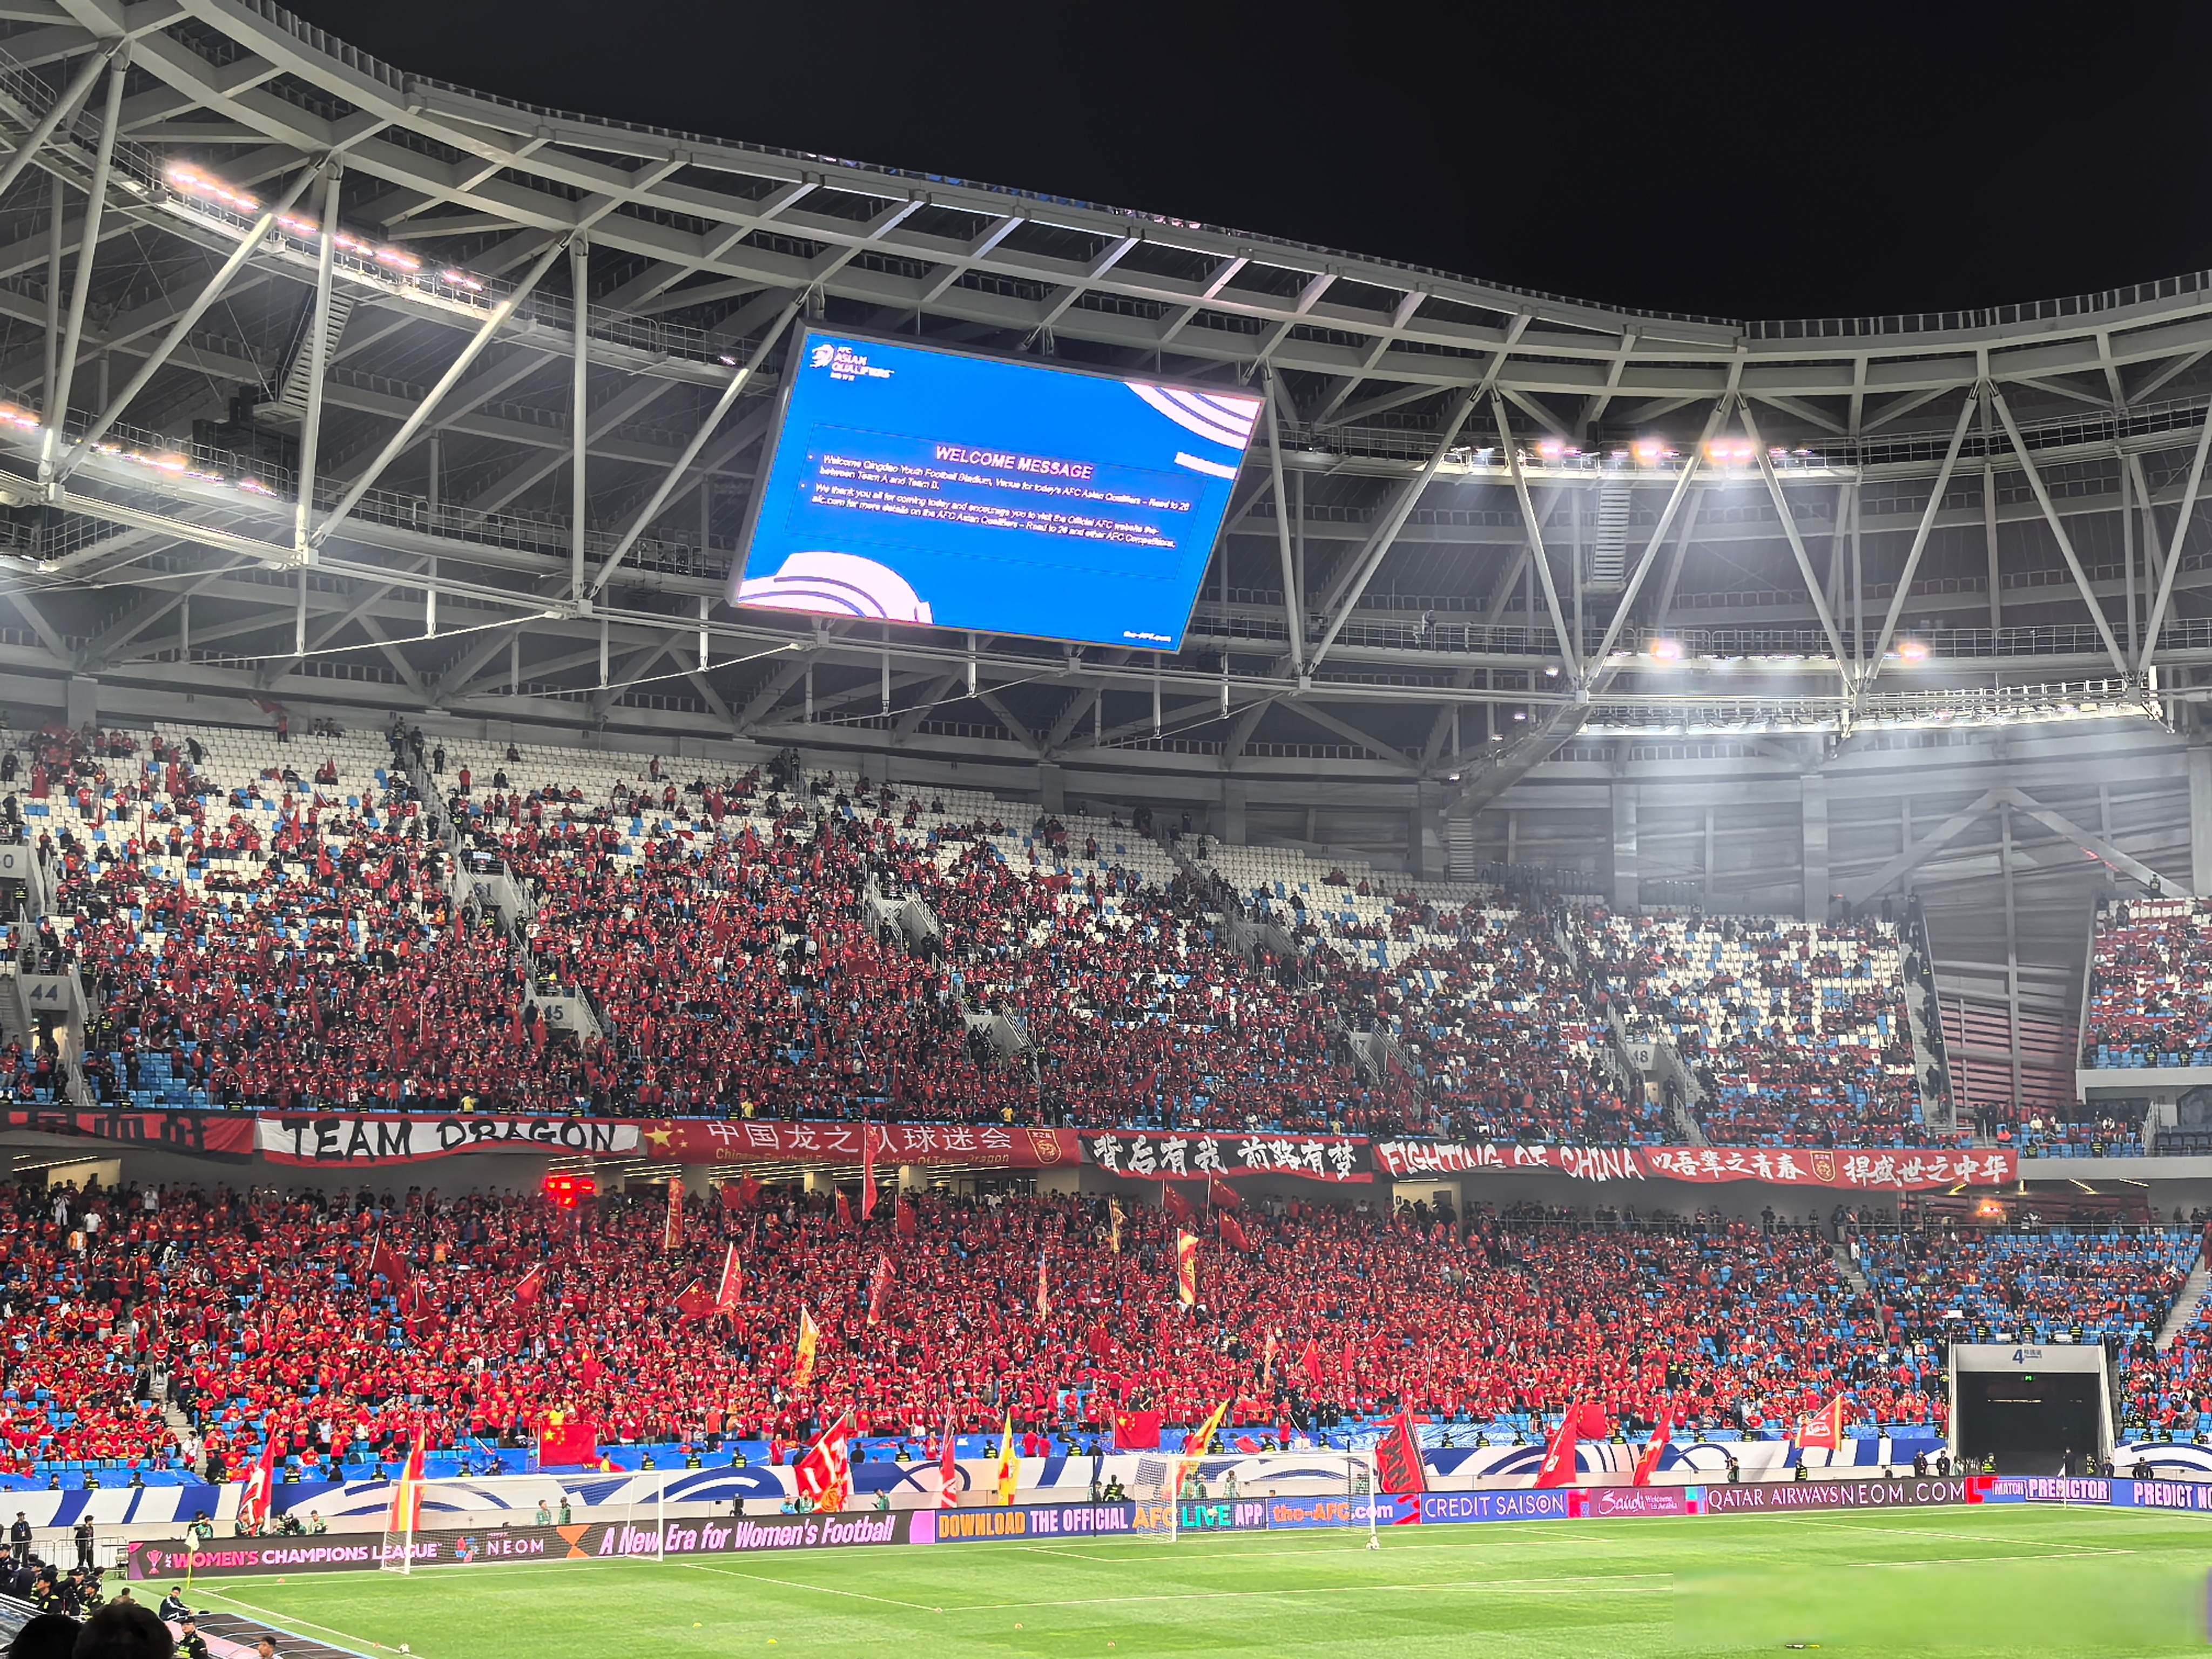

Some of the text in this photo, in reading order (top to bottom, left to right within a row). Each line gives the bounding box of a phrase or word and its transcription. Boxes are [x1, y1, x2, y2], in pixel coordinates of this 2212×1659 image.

[834, 353, 868, 366] ASIAN
[937, 446, 1093, 479] WELCOME MESSAGE
[30, 983, 58, 1001] 44
[282, 1117, 616, 1162] TEAM DRAGON
[1093, 1132, 1357, 1181] 背后有我 前路有梦
[1379, 1141, 1645, 1181] FIGHTING OF CHINA
[1651, 1150, 1808, 1181] 以吾辈之青春
[2012, 1349, 2025, 1364] 4
[1709, 1486, 1838, 1510] QATAR AIRWAYS
[1841, 1482, 1965, 1503] NEOM.COM
[2133, 1482, 2193, 1508] PREDICT
[1425, 1494, 1564, 1518] CREDIT SAISON
[939, 1504, 1263, 1538] DOWNLOAD THE OFFICIAL AFC LIVE APP
[487, 1538, 544, 1555] NEOM
[598, 1514, 896, 1555] A New Era for Women's Football
[173, 1550, 258, 1569] WOMEN'S
[262, 1546, 368, 1565] CHAMPIONS
